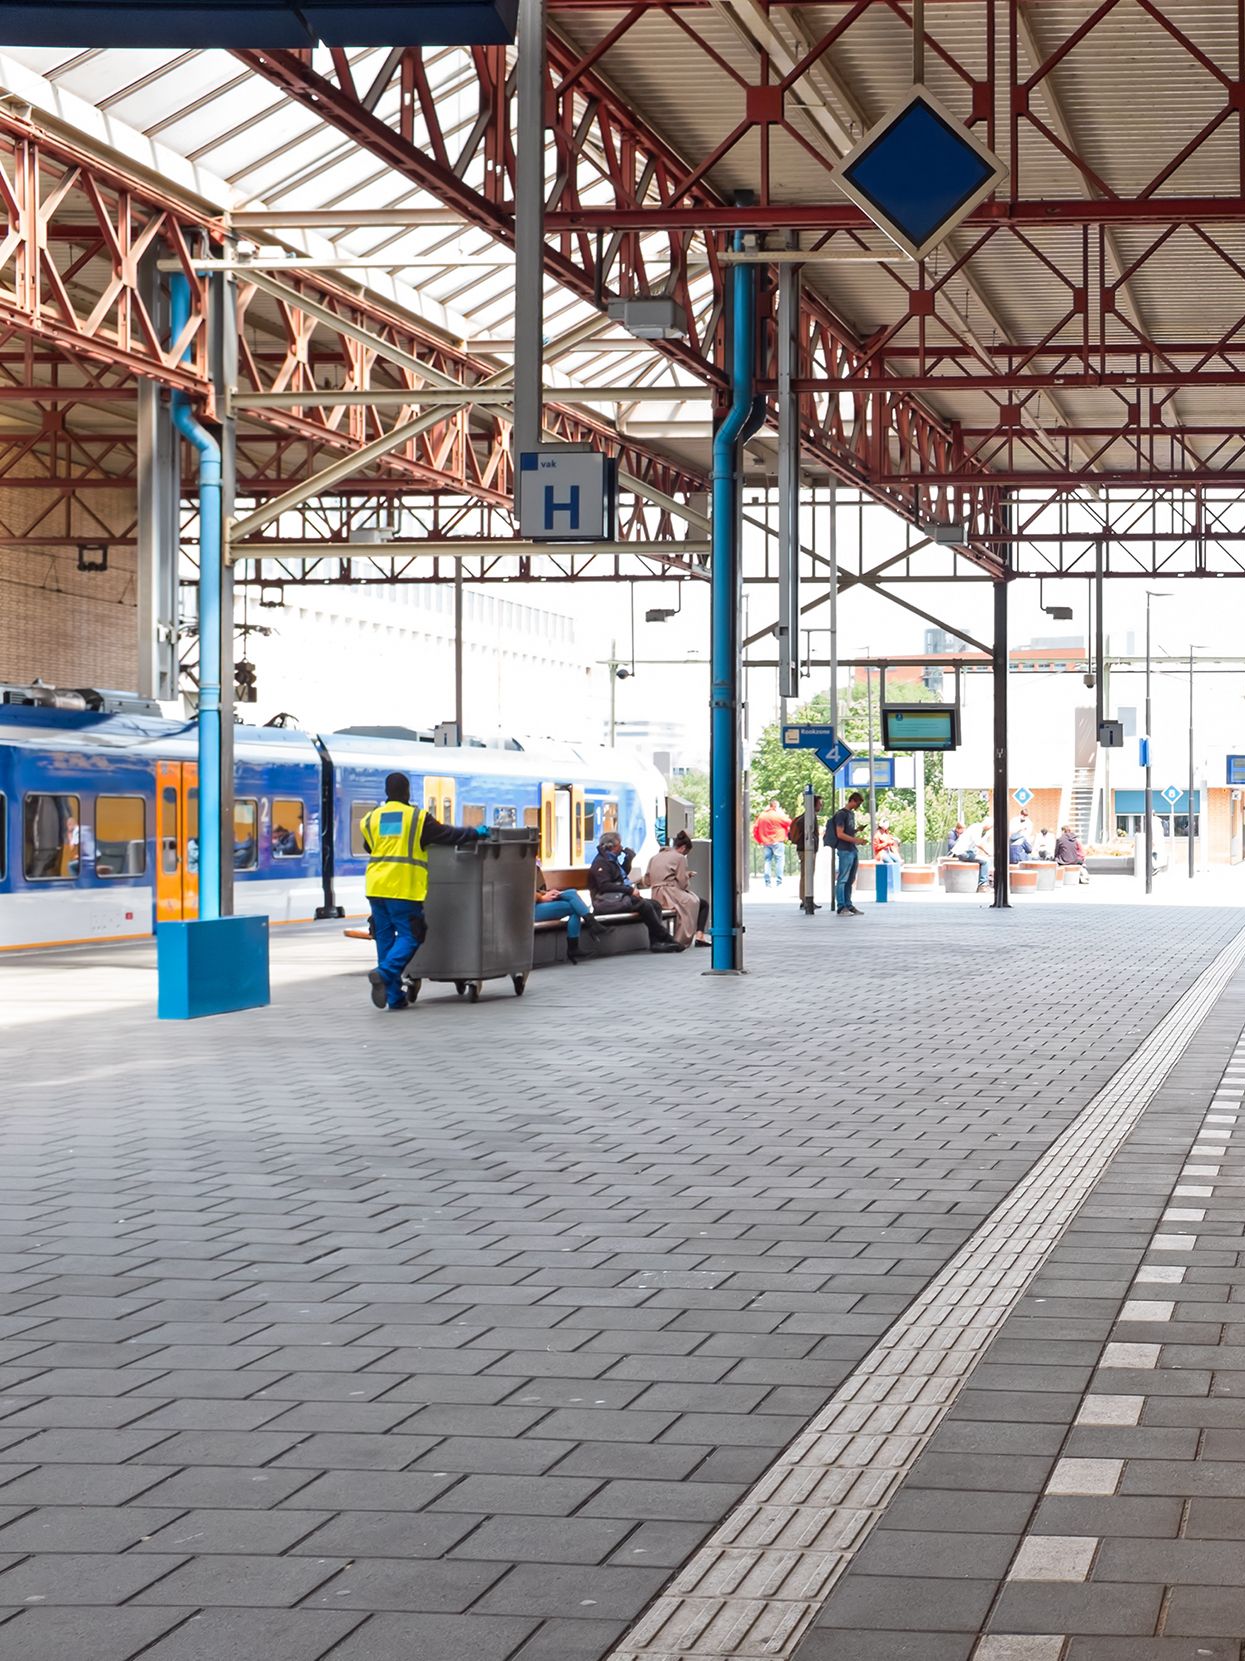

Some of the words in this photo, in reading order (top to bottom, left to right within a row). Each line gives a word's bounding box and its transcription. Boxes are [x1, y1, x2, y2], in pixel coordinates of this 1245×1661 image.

[541, 460, 557, 468] vak
[544, 485, 580, 530] H
[825, 744, 841, 762] 4
[260, 796, 269, 822] 2
[595, 806, 602, 825] 1
